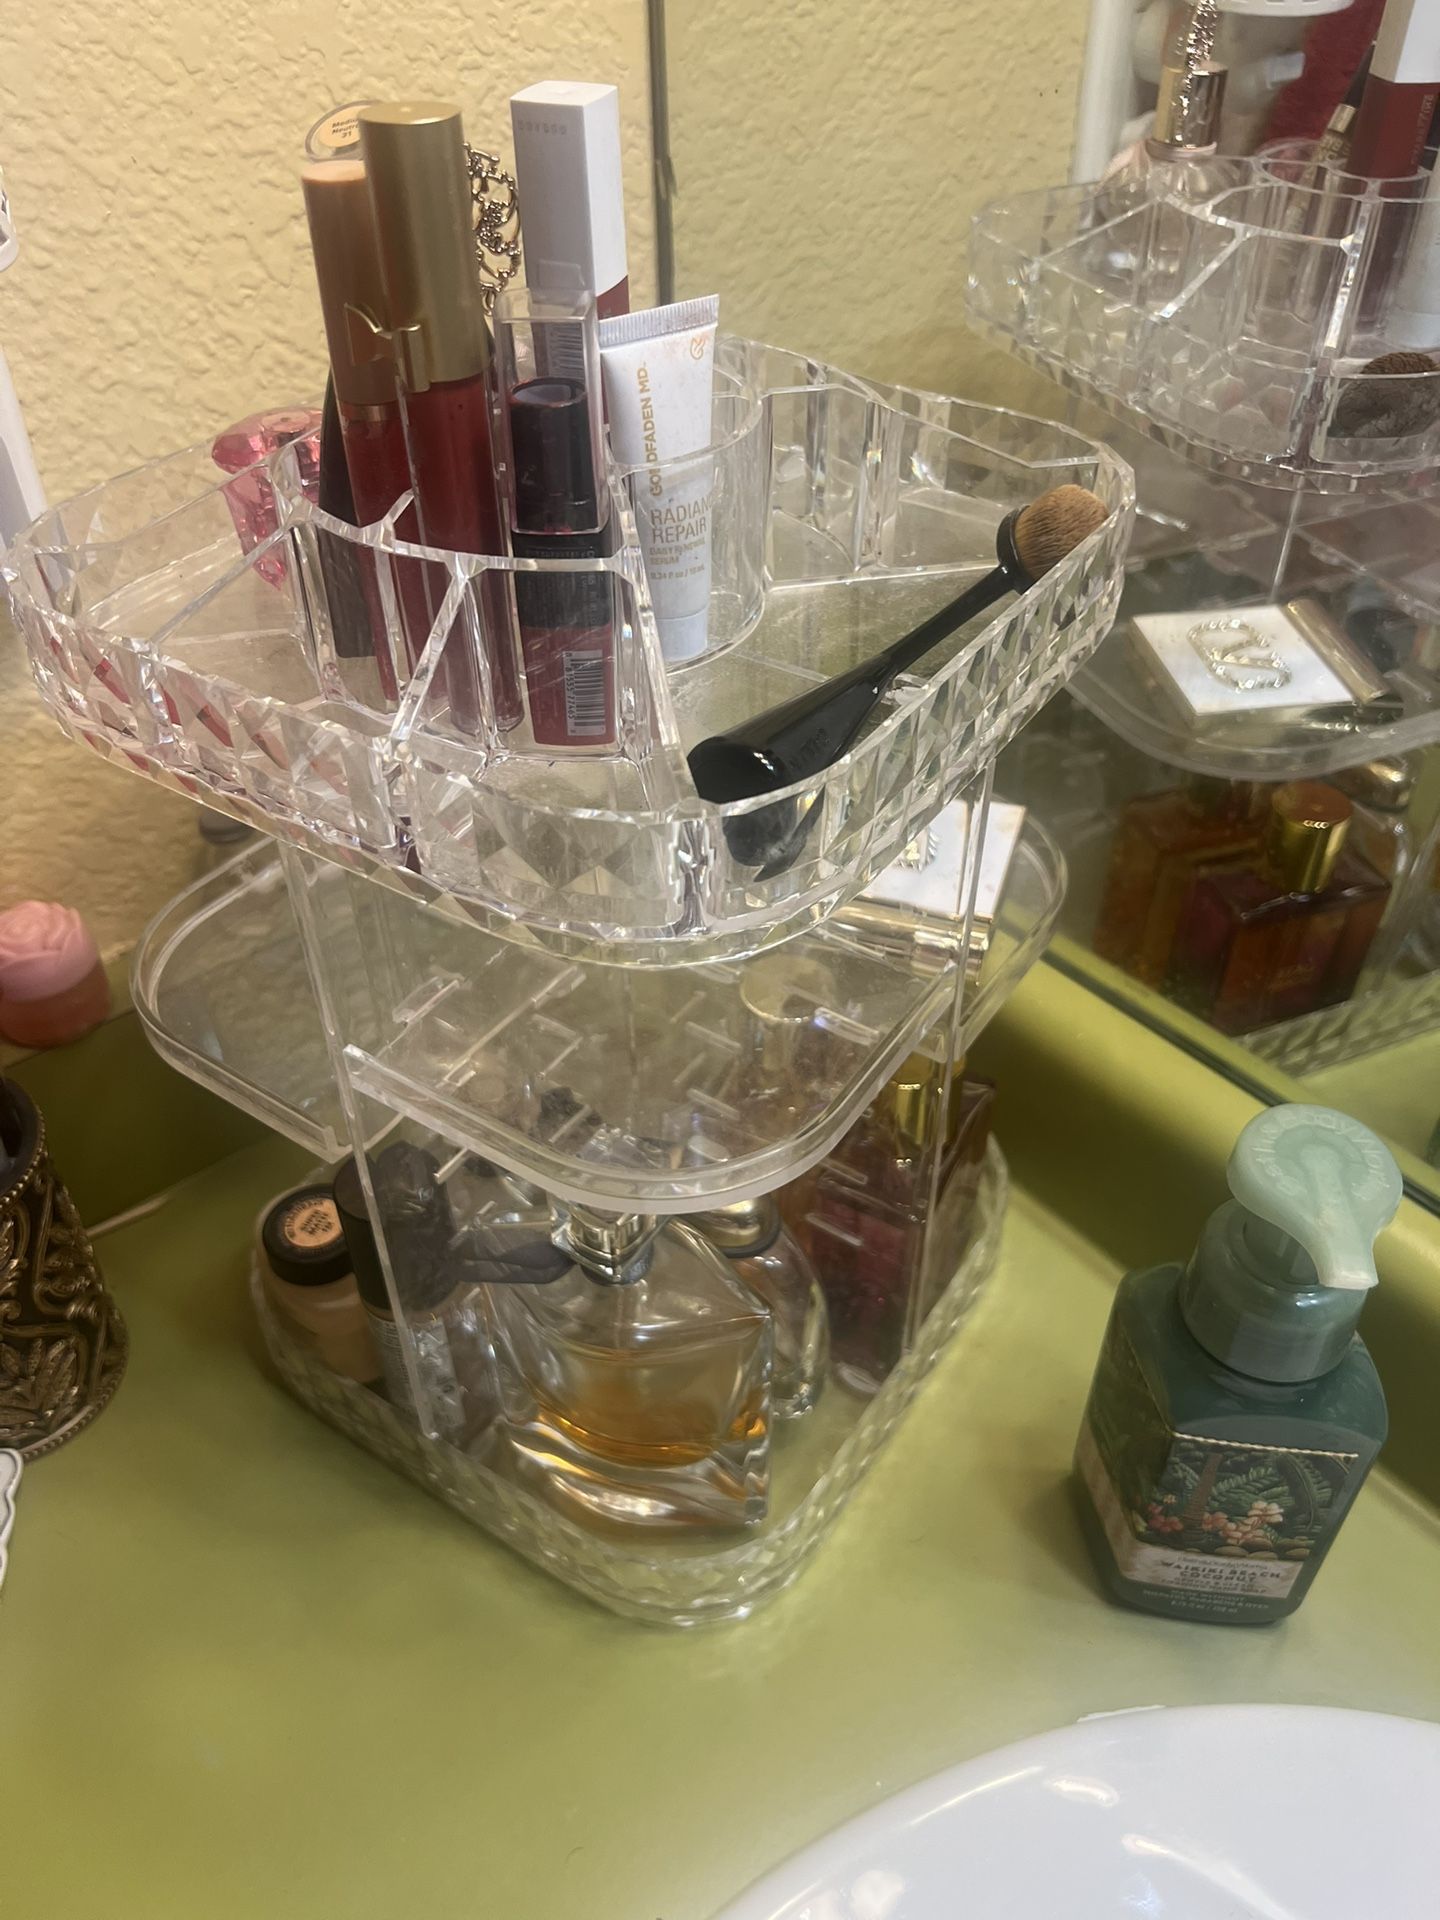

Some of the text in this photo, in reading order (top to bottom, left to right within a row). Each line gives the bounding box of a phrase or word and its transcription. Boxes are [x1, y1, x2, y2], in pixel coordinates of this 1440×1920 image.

[650, 495, 712, 526] RADIAN
[652, 516, 707, 544] REPAIR
[1180, 1570, 1257, 1582] COCONUT
